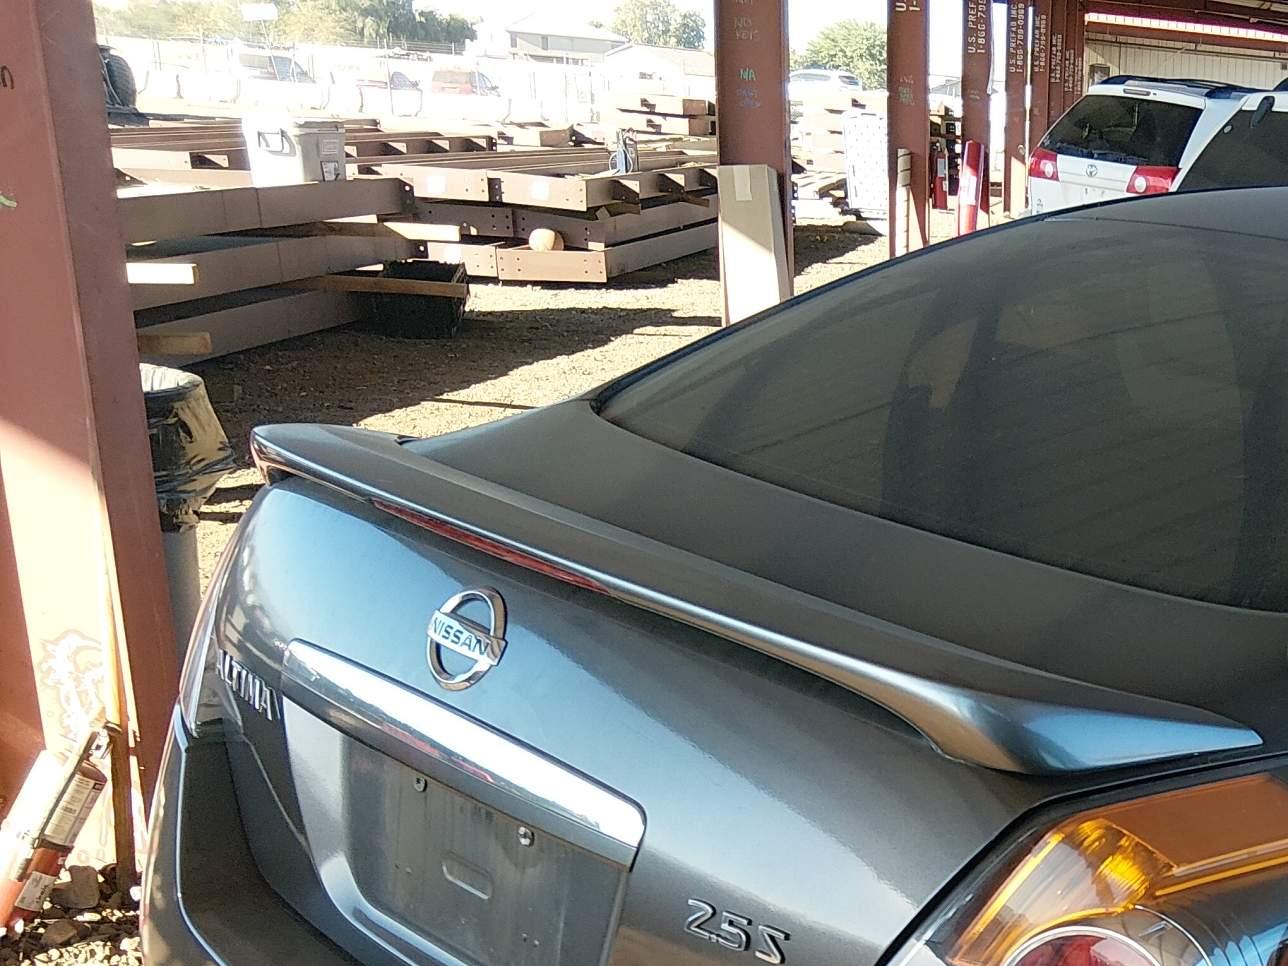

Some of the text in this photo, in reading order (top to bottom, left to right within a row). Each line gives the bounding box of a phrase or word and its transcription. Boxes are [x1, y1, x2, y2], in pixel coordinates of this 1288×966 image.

[967, 33, 977, 54] U.S.
[433, 616, 490, 656] NISSAN
[215, 649, 281, 721] ALTIMA
[684, 898, 791, 965] 2.5 S
